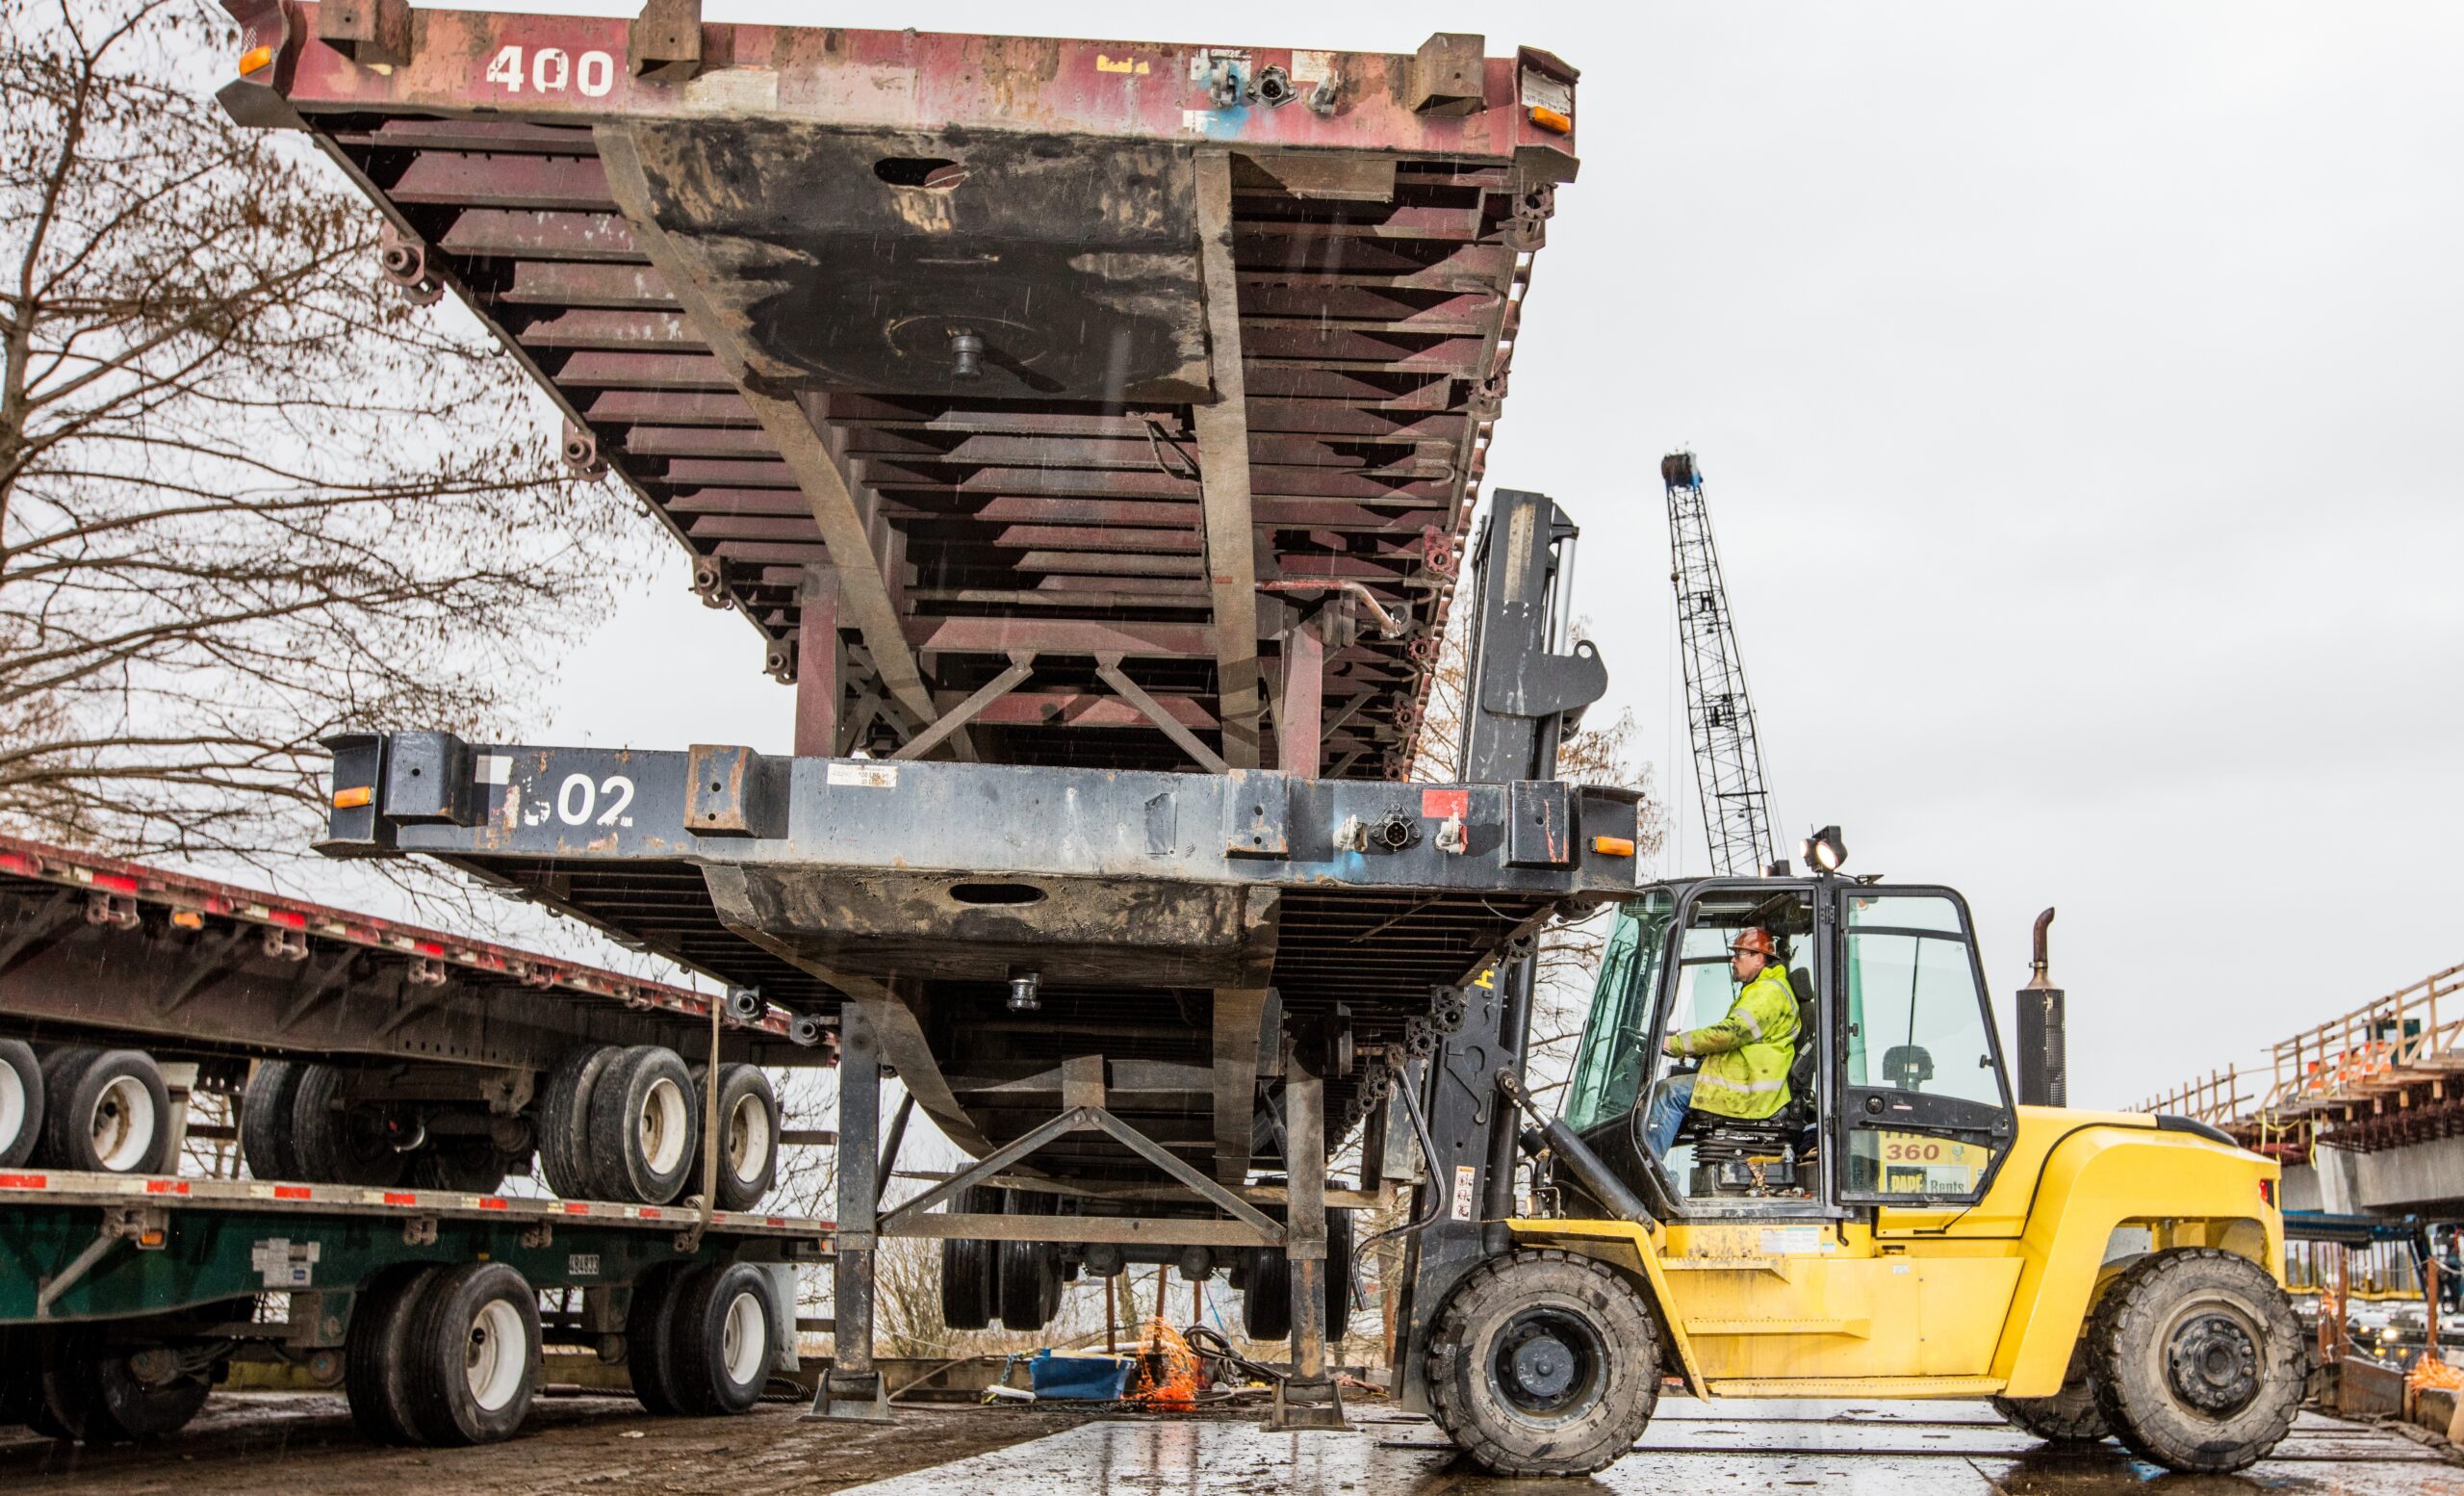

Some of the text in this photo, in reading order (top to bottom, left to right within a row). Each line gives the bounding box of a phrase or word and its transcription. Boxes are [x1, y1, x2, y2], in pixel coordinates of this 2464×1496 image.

[486, 45, 614, 97] 400
[1886, 1144, 1940, 1161] 360
[1930, 1179, 1964, 1195] Rents
